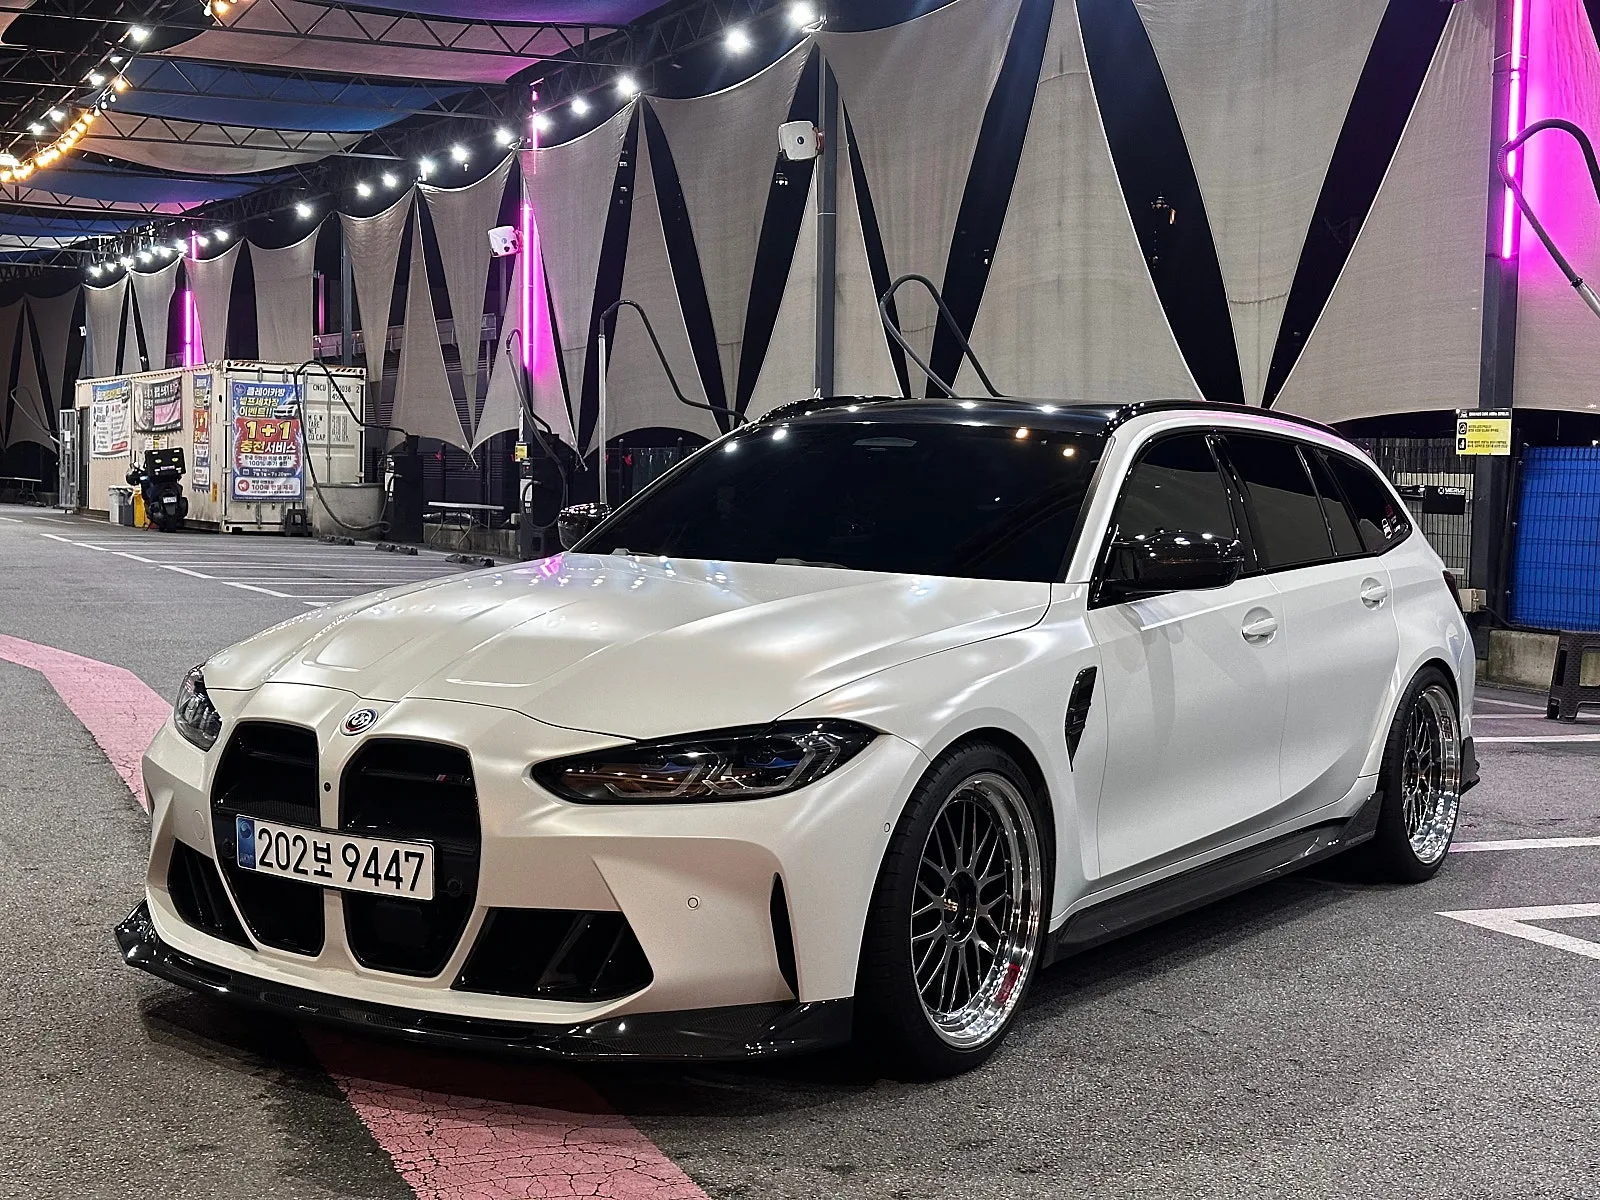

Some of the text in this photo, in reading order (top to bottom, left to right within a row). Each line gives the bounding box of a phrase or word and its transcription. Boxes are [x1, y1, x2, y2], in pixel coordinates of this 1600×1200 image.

[239, 397, 280, 407] 셀프세차장
[239, 406, 272, 418] 이벤트!!
[246, 421, 292, 440] 1+1
[257, 828, 425, 891] 202보 9447
